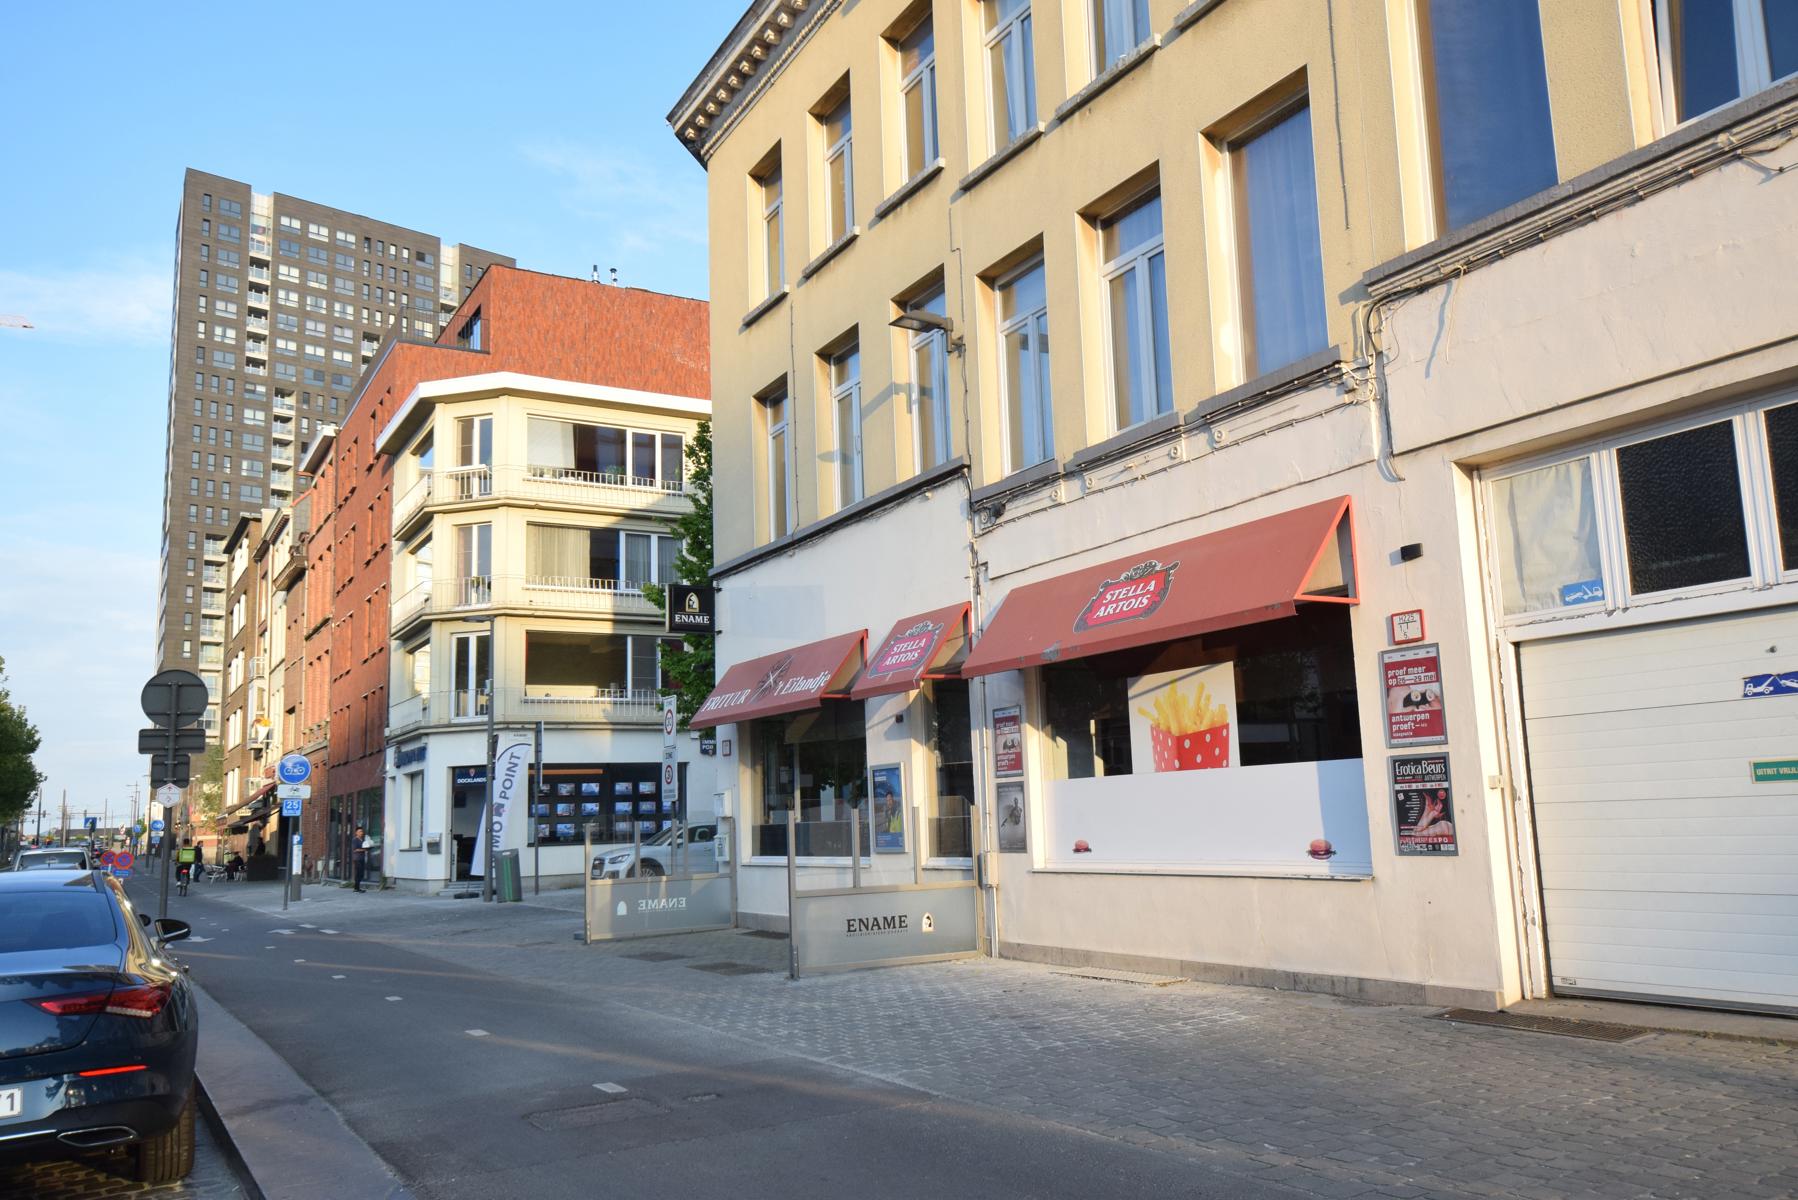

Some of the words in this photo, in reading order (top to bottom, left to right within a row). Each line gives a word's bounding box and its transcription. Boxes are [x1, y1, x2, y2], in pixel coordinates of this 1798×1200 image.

[1103, 580, 1156, 603] STELLA
[1094, 594, 1151, 618] ARTOIS
[674, 614, 710, 624] ENAME
[891, 638, 926, 655] STELLA
[883, 650, 920, 667] ARTOIS
[1407, 666, 1426, 674] meer
[1388, 678, 1397, 686] op
[700, 688, 751, 712] FRITUUR
[780, 670, 831, 696] Eilandje
[1391, 712, 1430, 722] antwerpen
[499, 752, 521, 801] POINT
[1395, 762, 1422, 776] Erotica
[1421, 760, 1445, 774] Beurs
[286, 801, 299, 809] 25
[846, 914, 908, 933] ENAME
[0, 1092, 15, 1112] 1
